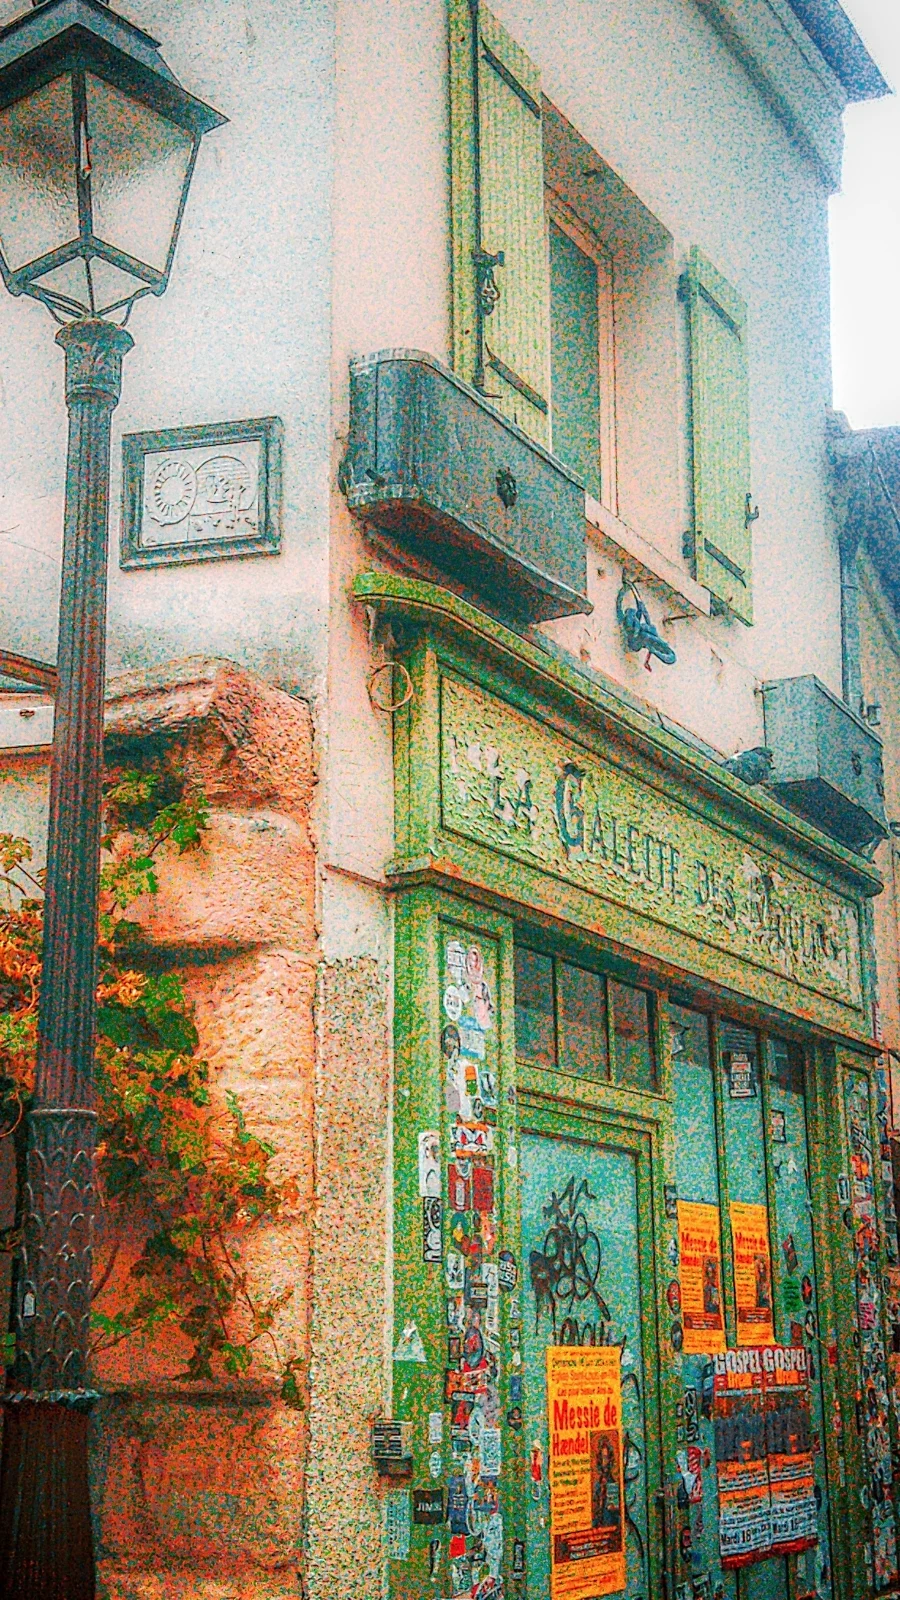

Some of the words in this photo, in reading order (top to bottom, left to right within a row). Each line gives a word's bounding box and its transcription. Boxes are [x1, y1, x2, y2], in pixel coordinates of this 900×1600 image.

[491, 774, 537, 832] LA
[713, 1349, 762, 1375] GOSPEL
[763, 1347, 807, 1372] GOSPEL
[553, 1399, 600, 1431] Messie
[603, 1396, 617, 1428] de
